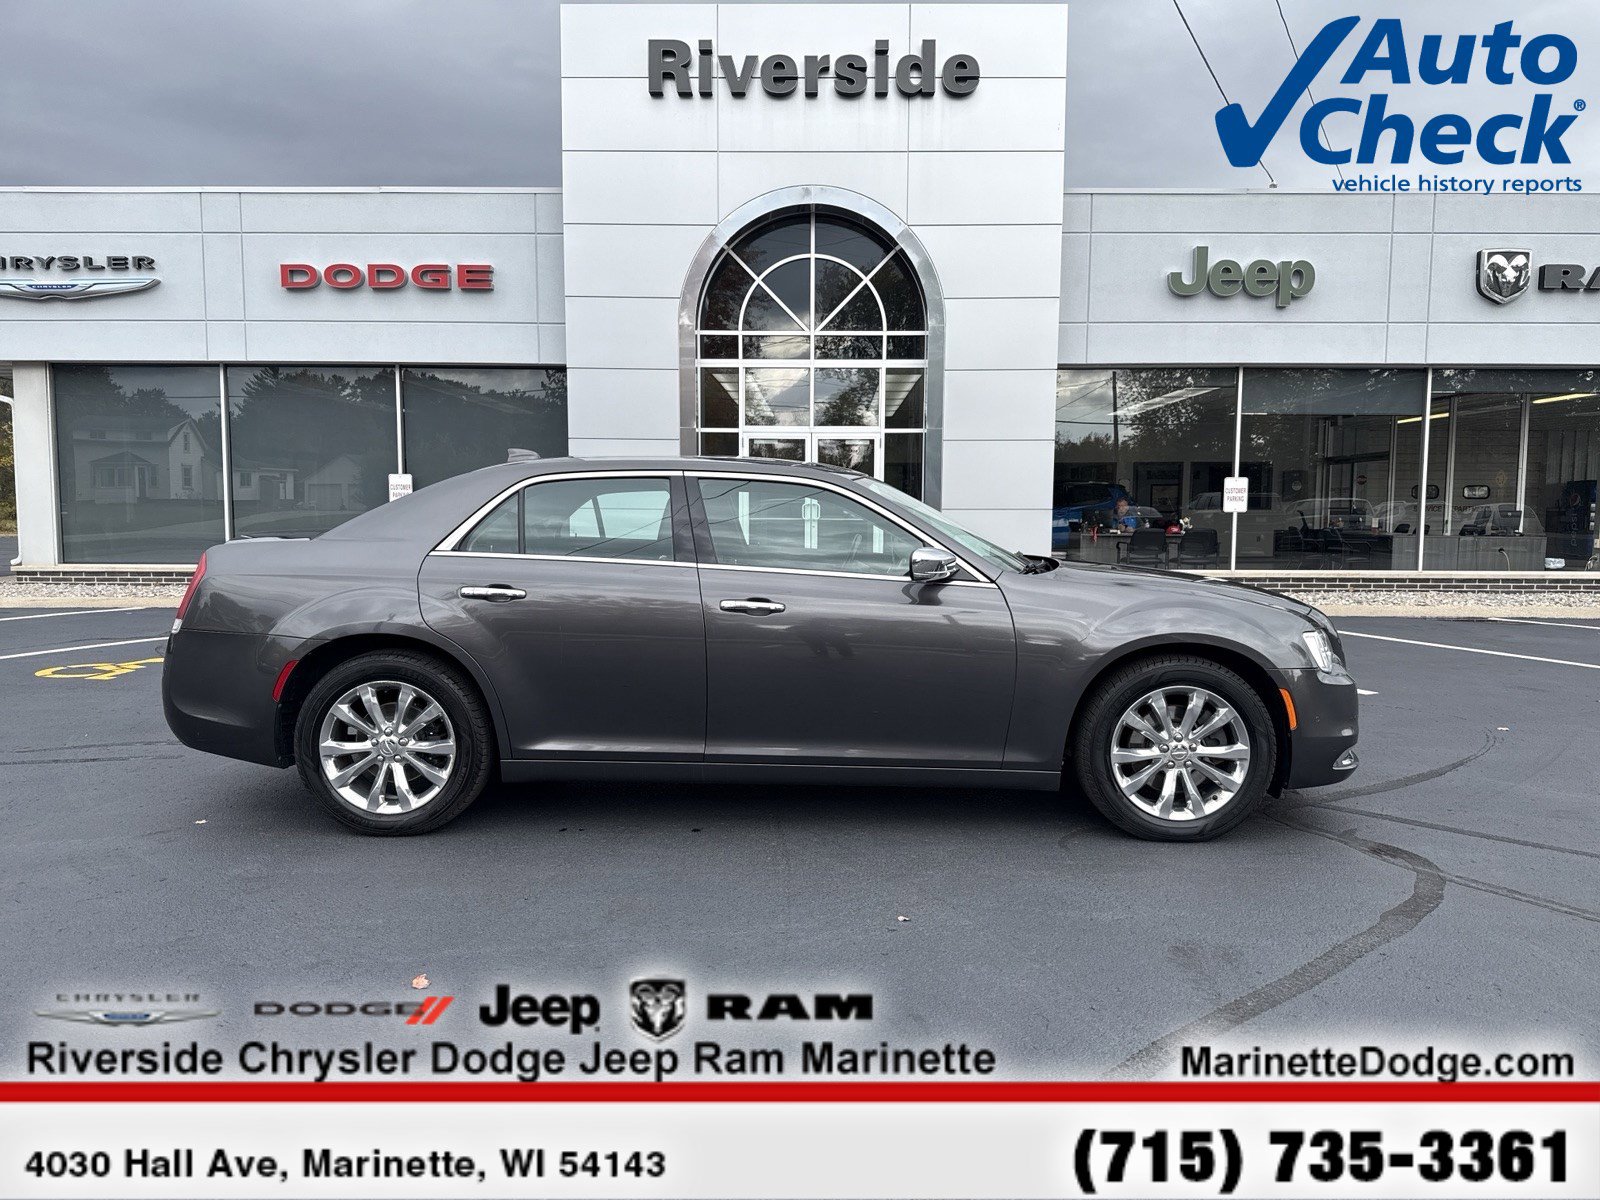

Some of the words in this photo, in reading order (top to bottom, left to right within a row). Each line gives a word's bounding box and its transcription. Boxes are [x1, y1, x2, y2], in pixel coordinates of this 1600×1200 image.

[648, 39, 980, 98] Riverside
[0, 255, 156, 271] RYSLER
[280, 263, 495, 290] DODGE
[1167, 246, 1316, 308] Jeep
[1538, 264, 1600, 291] R
